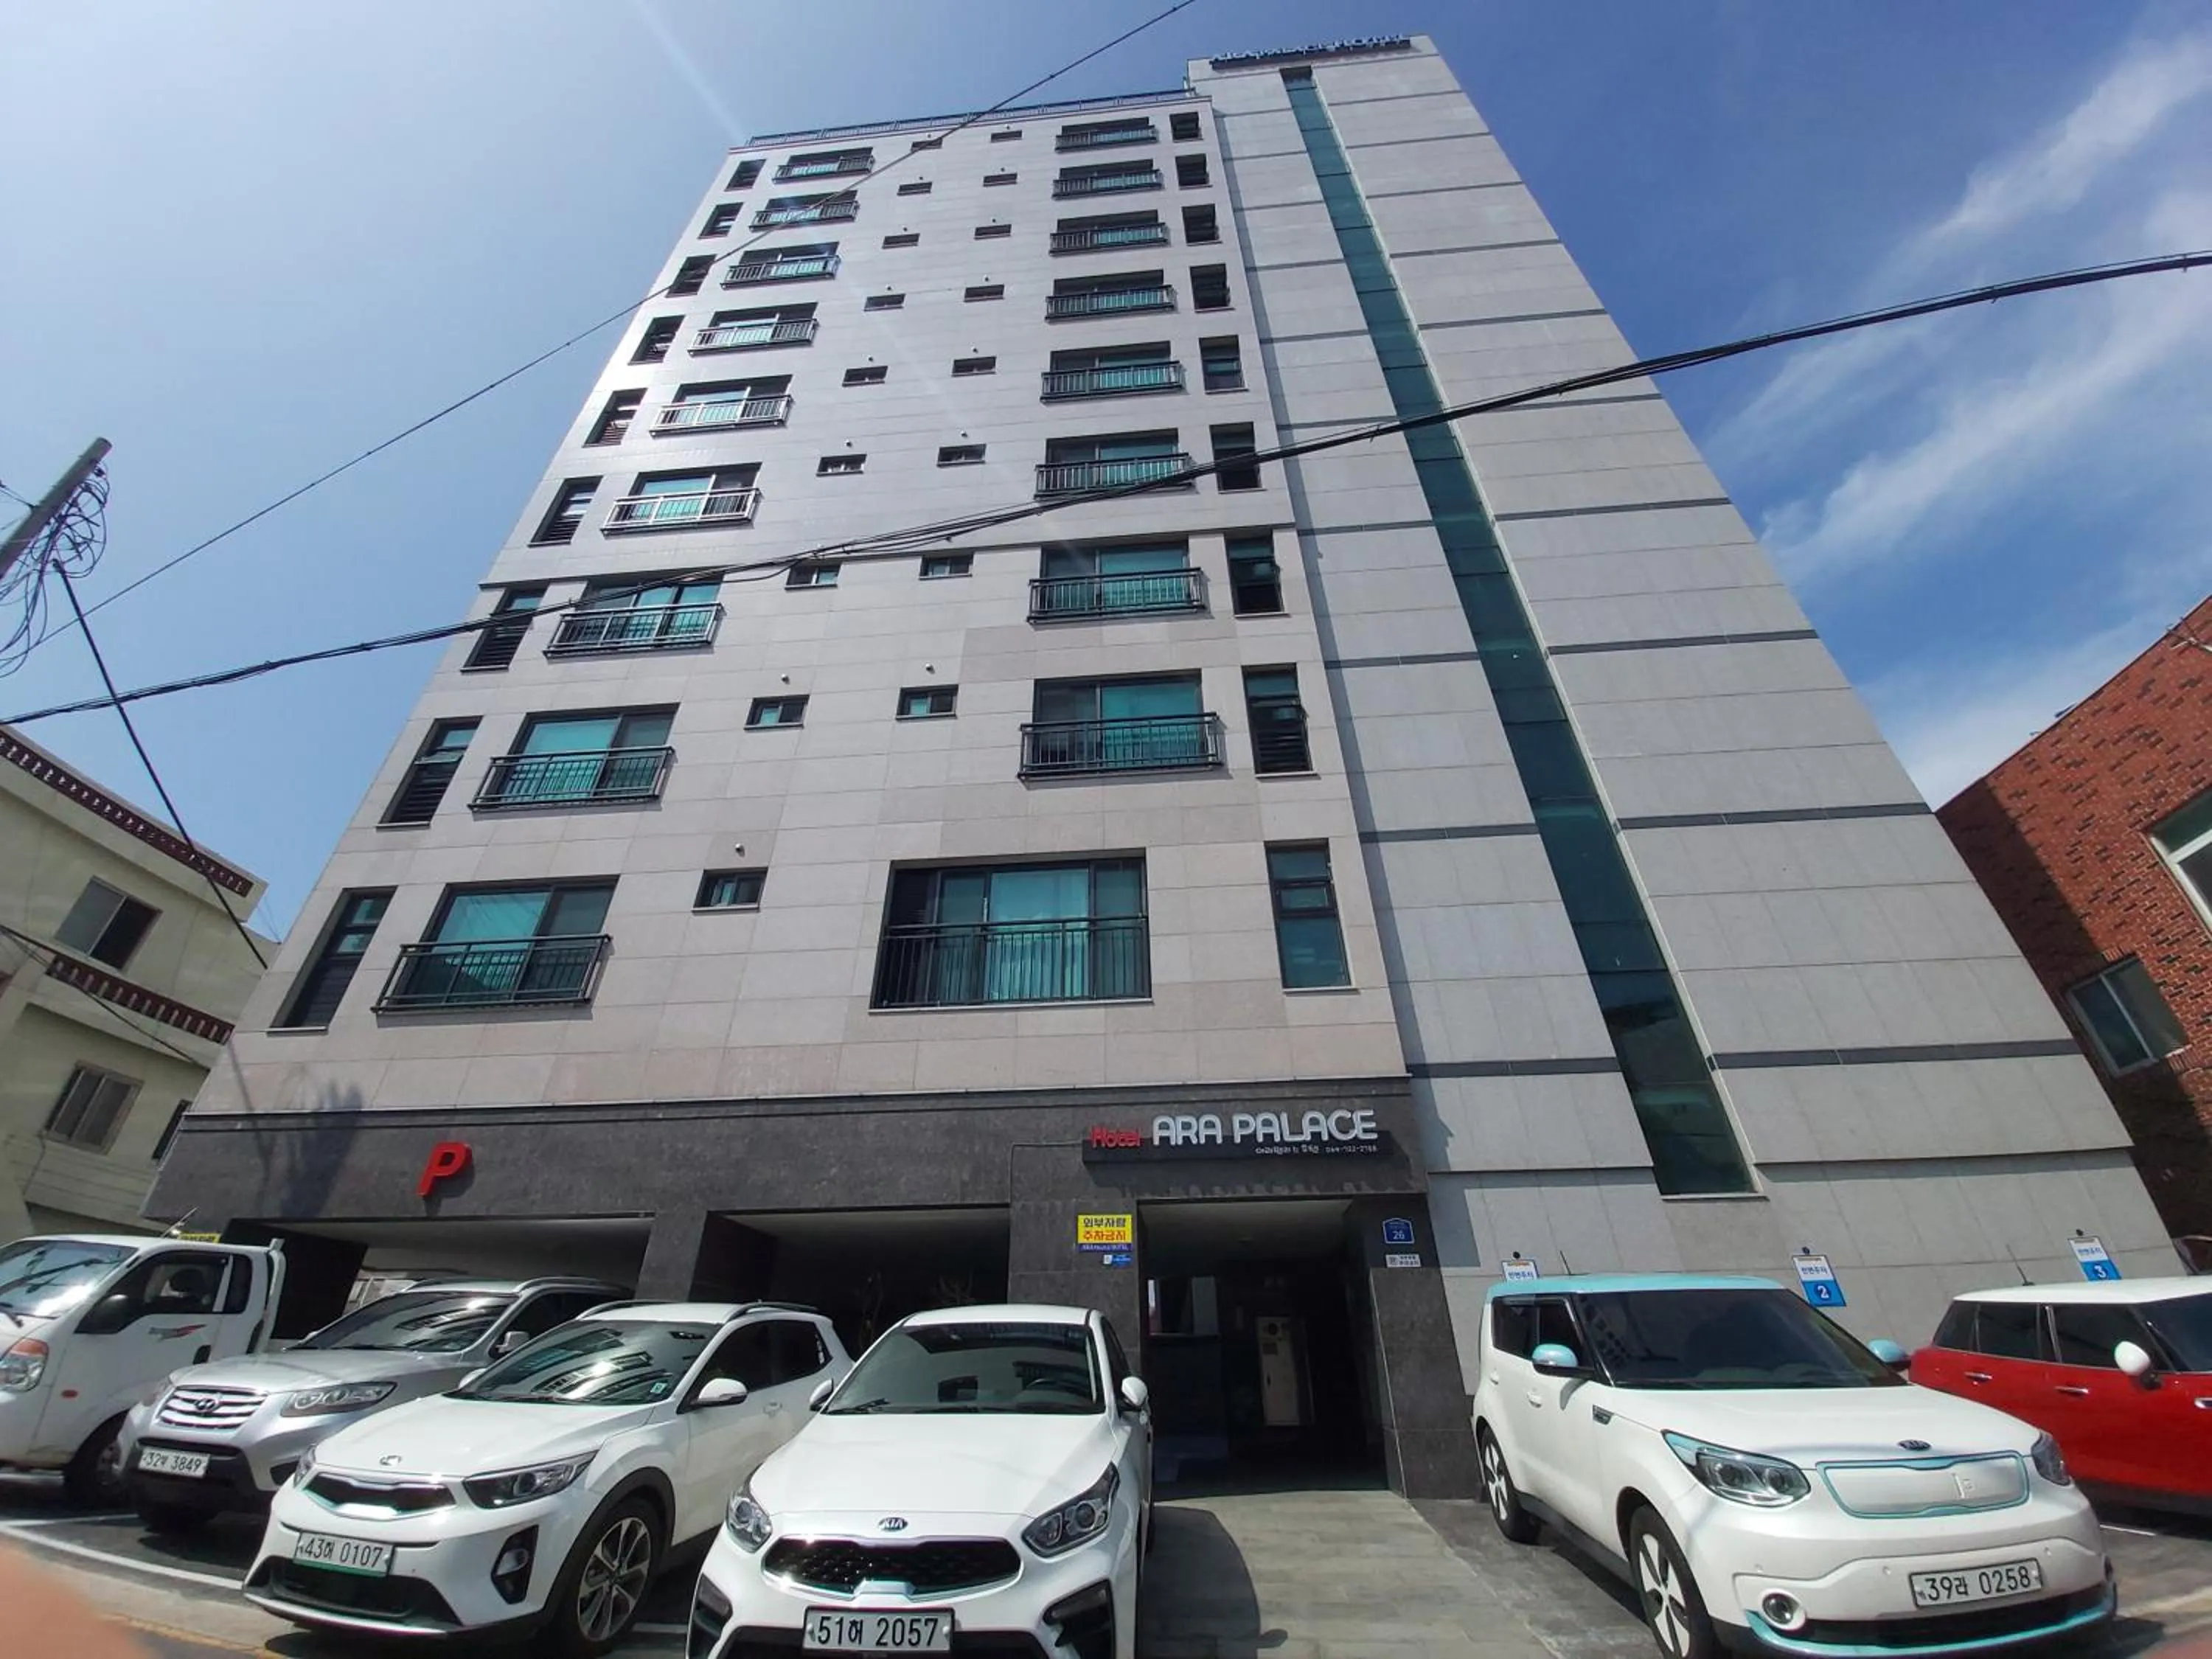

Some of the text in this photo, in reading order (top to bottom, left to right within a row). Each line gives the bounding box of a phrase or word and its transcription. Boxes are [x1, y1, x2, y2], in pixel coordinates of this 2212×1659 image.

[1091, 1109, 1378, 1148] Hotel ARA PALACE
[417, 1141, 471, 1197] P
[1083, 1217, 1126, 1228] 외부차량
[1083, 1229, 1126, 1241] 주차금지
[1392, 1230, 1405, 1239] 26
[2094, 1264, 2107, 1278] 3
[1817, 1285, 1829, 1298] 2
[170, 1455, 202, 1472] 3849
[339, 1542, 383, 1568] 0107
[1924, 1565, 2031, 1601] 39라 0258
[818, 1615, 938, 1646] 51허 2057
